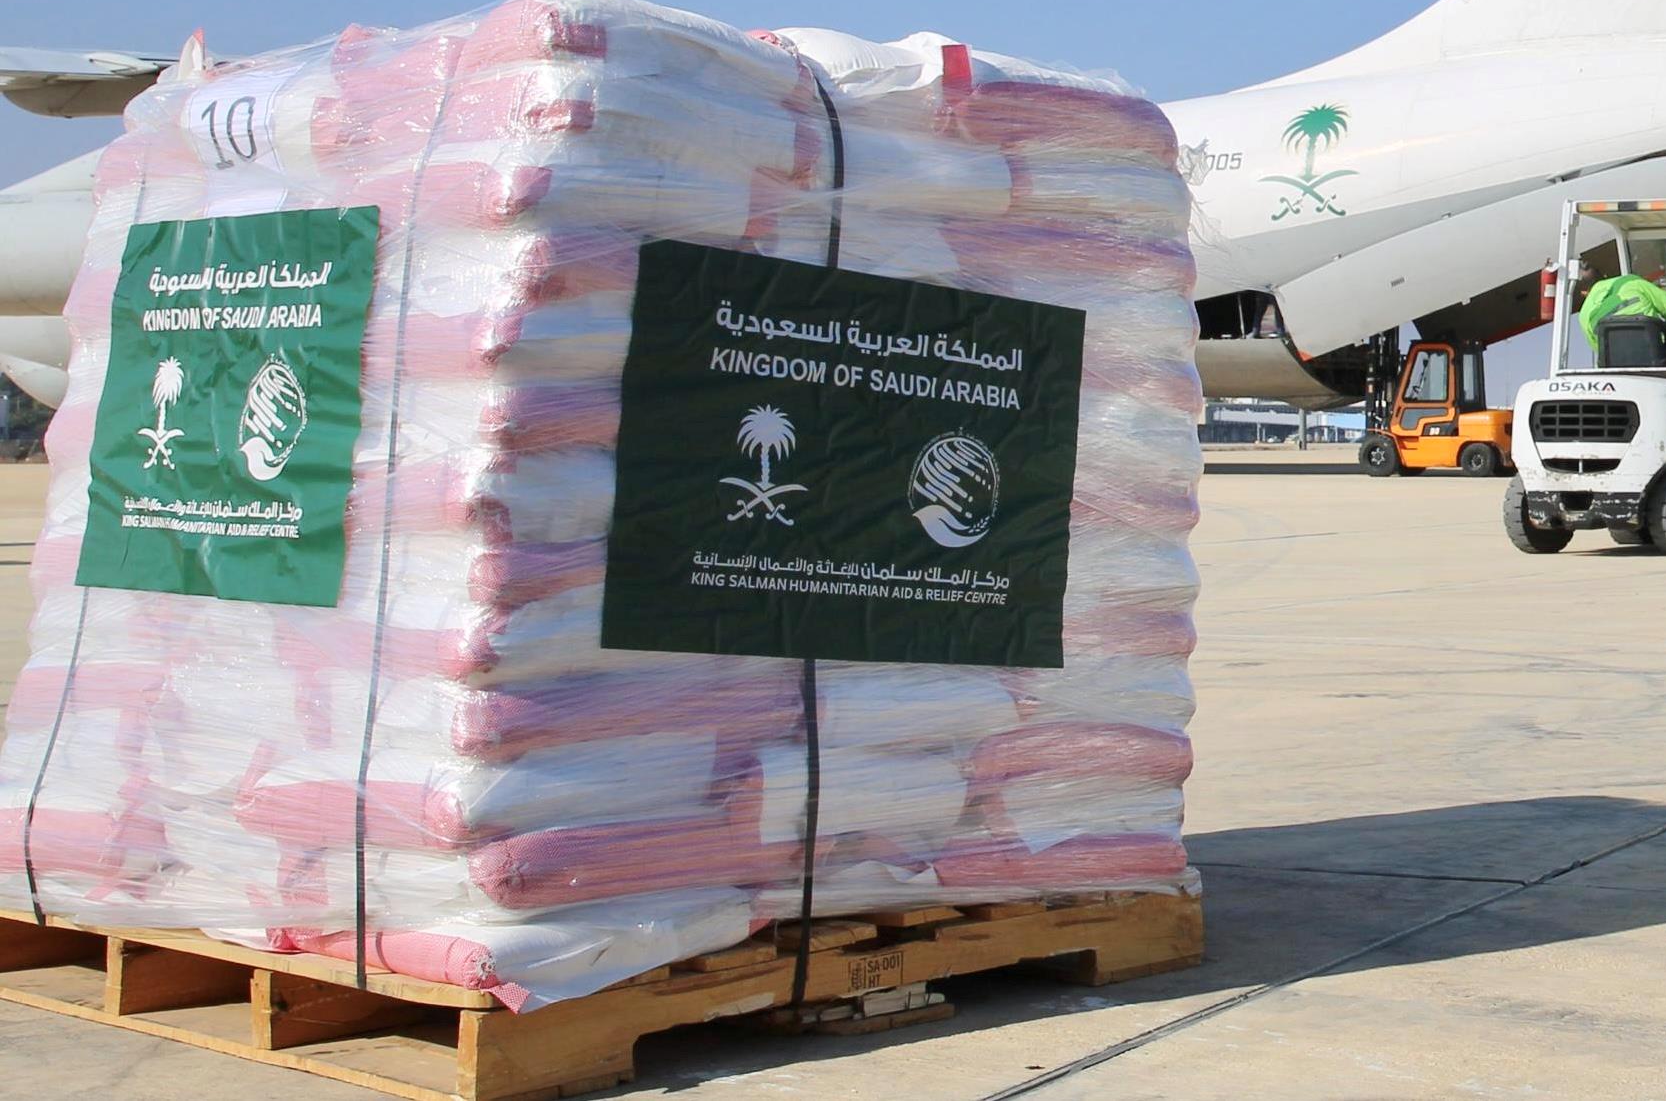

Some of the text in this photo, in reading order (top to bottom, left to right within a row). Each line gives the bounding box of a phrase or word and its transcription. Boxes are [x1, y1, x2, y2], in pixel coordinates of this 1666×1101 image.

[200, 95, 259, 170] 10
[215, 263, 268, 294] العربية
[143, 304, 322, 331] KINGDOM OF SAUDI ARABIA
[716, 300, 1023, 371] المملكة العربية السعودية
[710, 347, 1021, 410] KINGDOM OF SAUDI ARABIA
[1549, 381, 1616, 392] OSAKA
[248, 501, 277, 519] الملك
[122, 515, 139, 527] KING
[227, 524, 240, 536] AID
[270, 524, 299, 539] CENTRE
[693, 551, 1010, 590] مركز الملك سلمان للإغاثة والأعمال الإنسانية
[691, 572, 1008, 605] KING SALMAN HUMANITARIAN AID & RELIEF CENTRE
[868, 975, 880, 988] HT
